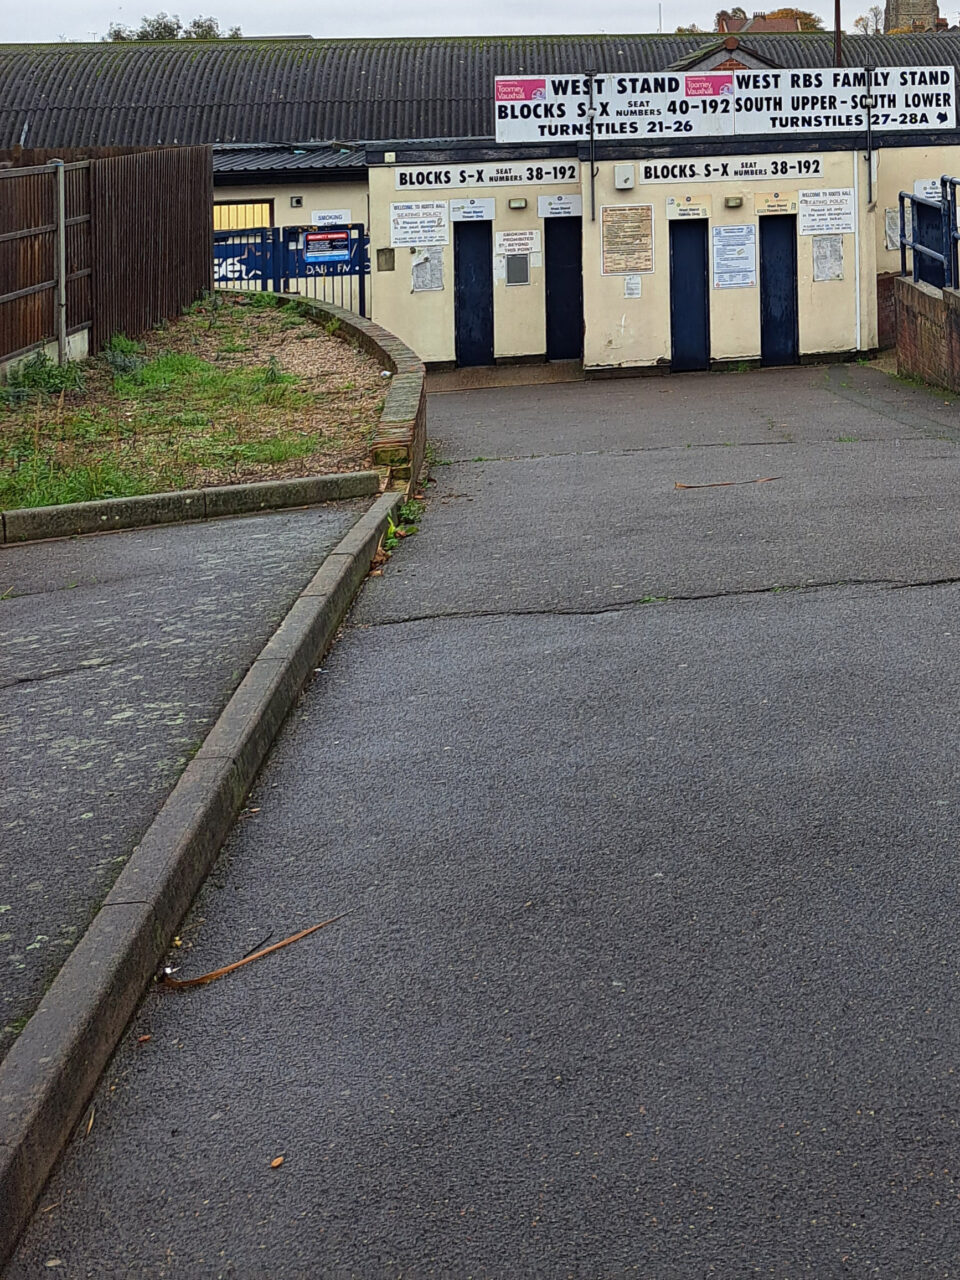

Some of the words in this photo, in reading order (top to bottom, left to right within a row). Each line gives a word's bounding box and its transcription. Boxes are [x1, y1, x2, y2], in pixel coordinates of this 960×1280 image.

[551, 79, 605, 95] WEST
[617, 78, 679, 93] STAND
[736, 74, 780, 89] WEST
[791, 73, 822, 88] RBS
[833, 72, 890, 87] FAMILY
[900, 71, 950, 86] STAND
[628, 100, 650, 108] SEAT
[667, 99, 730, 114] 40-192
[735, 97, 782, 112] SOUTH
[904, 93, 951, 108] LOWER
[498, 103, 566, 119] BLOCKS
[616, 108, 662, 116] NUMBERS
[538, 122, 638, 136] TURNSTILES
[647, 120, 693, 133] 21-26
[770, 115, 863, 128] TURNSTILES
[871, 112, 929, 125] 27-28A
[526, 166, 576, 181] 38-192
[644, 164, 695, 179] BLOCKS
[704, 163, 729, 177] S-X
[771, 160, 821, 175] 38-192
[400, 171, 451, 185] BLOCKS
[459, 169, 484, 183] S-X
